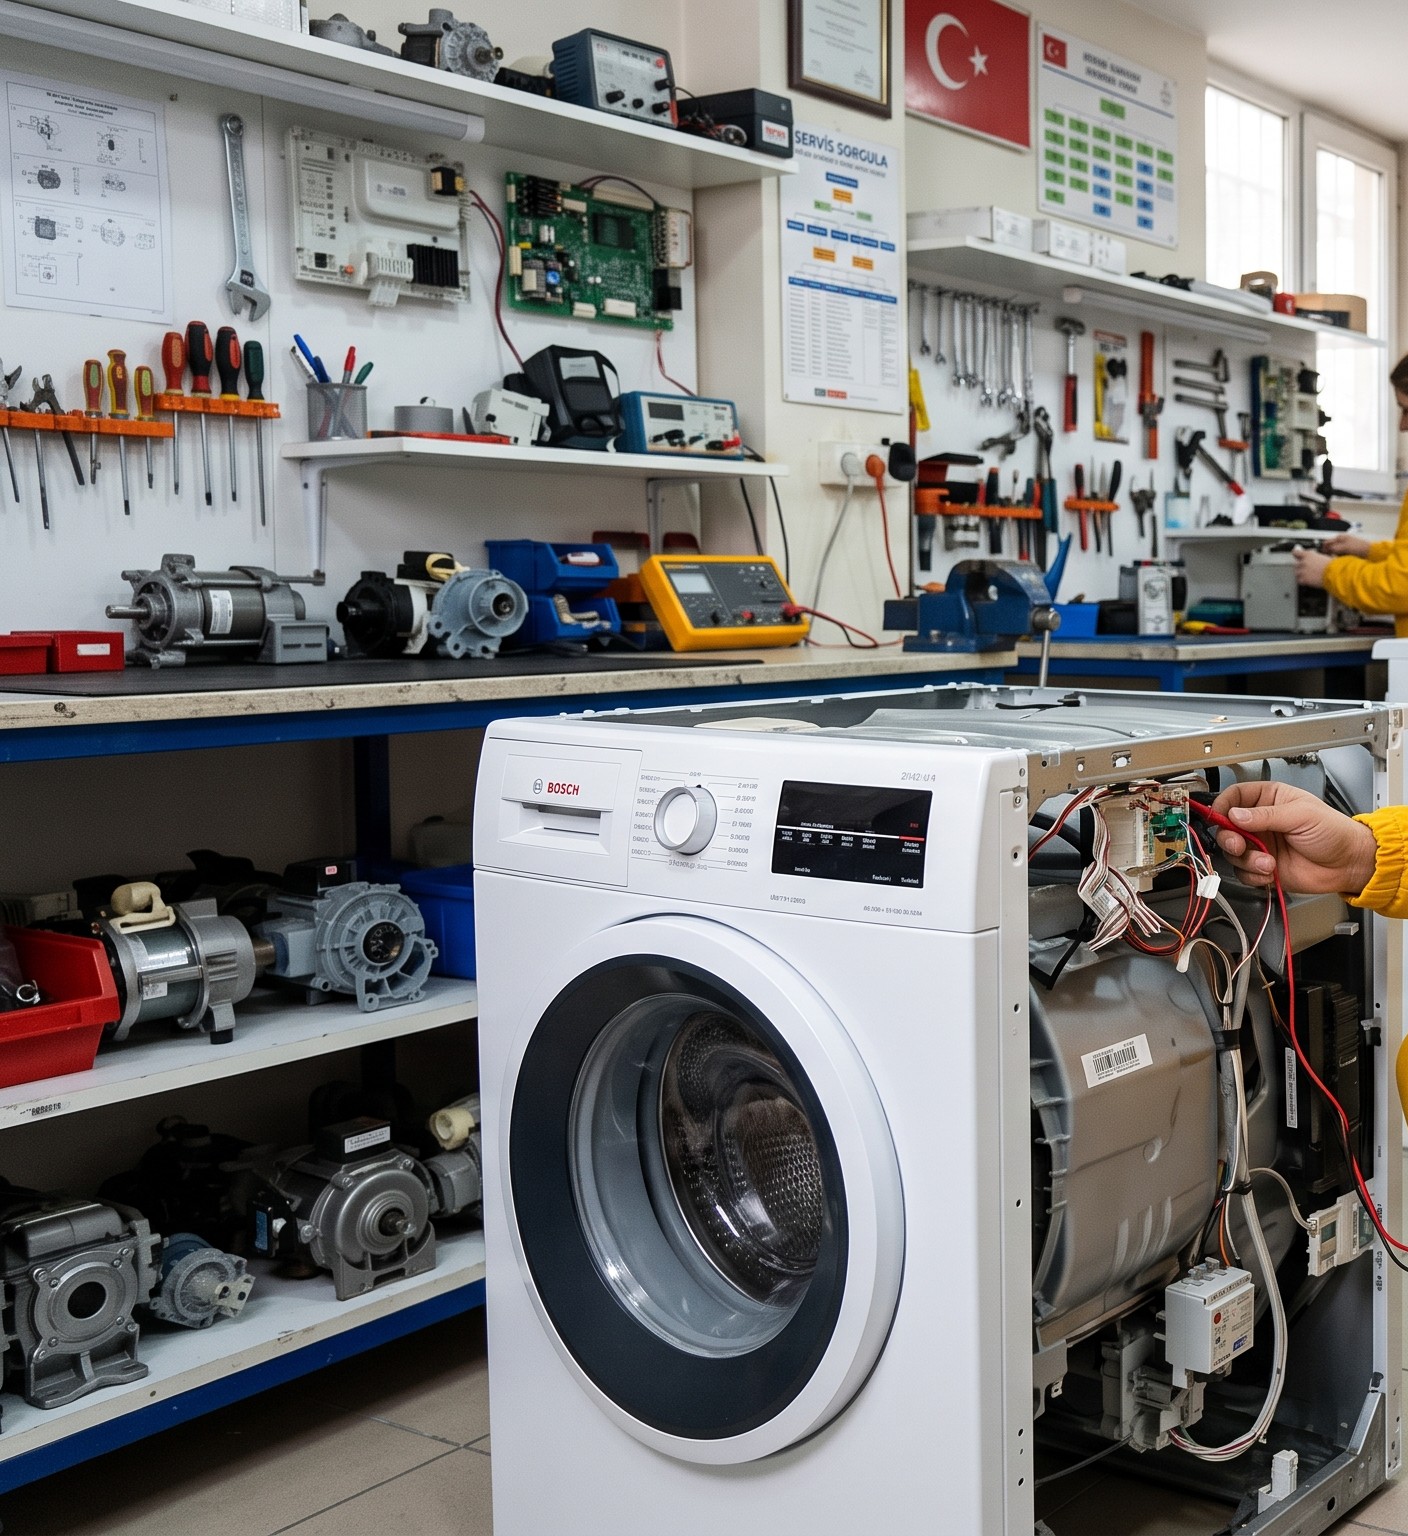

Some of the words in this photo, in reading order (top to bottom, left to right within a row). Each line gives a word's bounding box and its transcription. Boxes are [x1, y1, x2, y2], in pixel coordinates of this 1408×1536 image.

[795, 130, 834, 154] SERVİS
[837, 142, 888, 168] SORGULA
[547, 782, 580, 796] BOSCH
